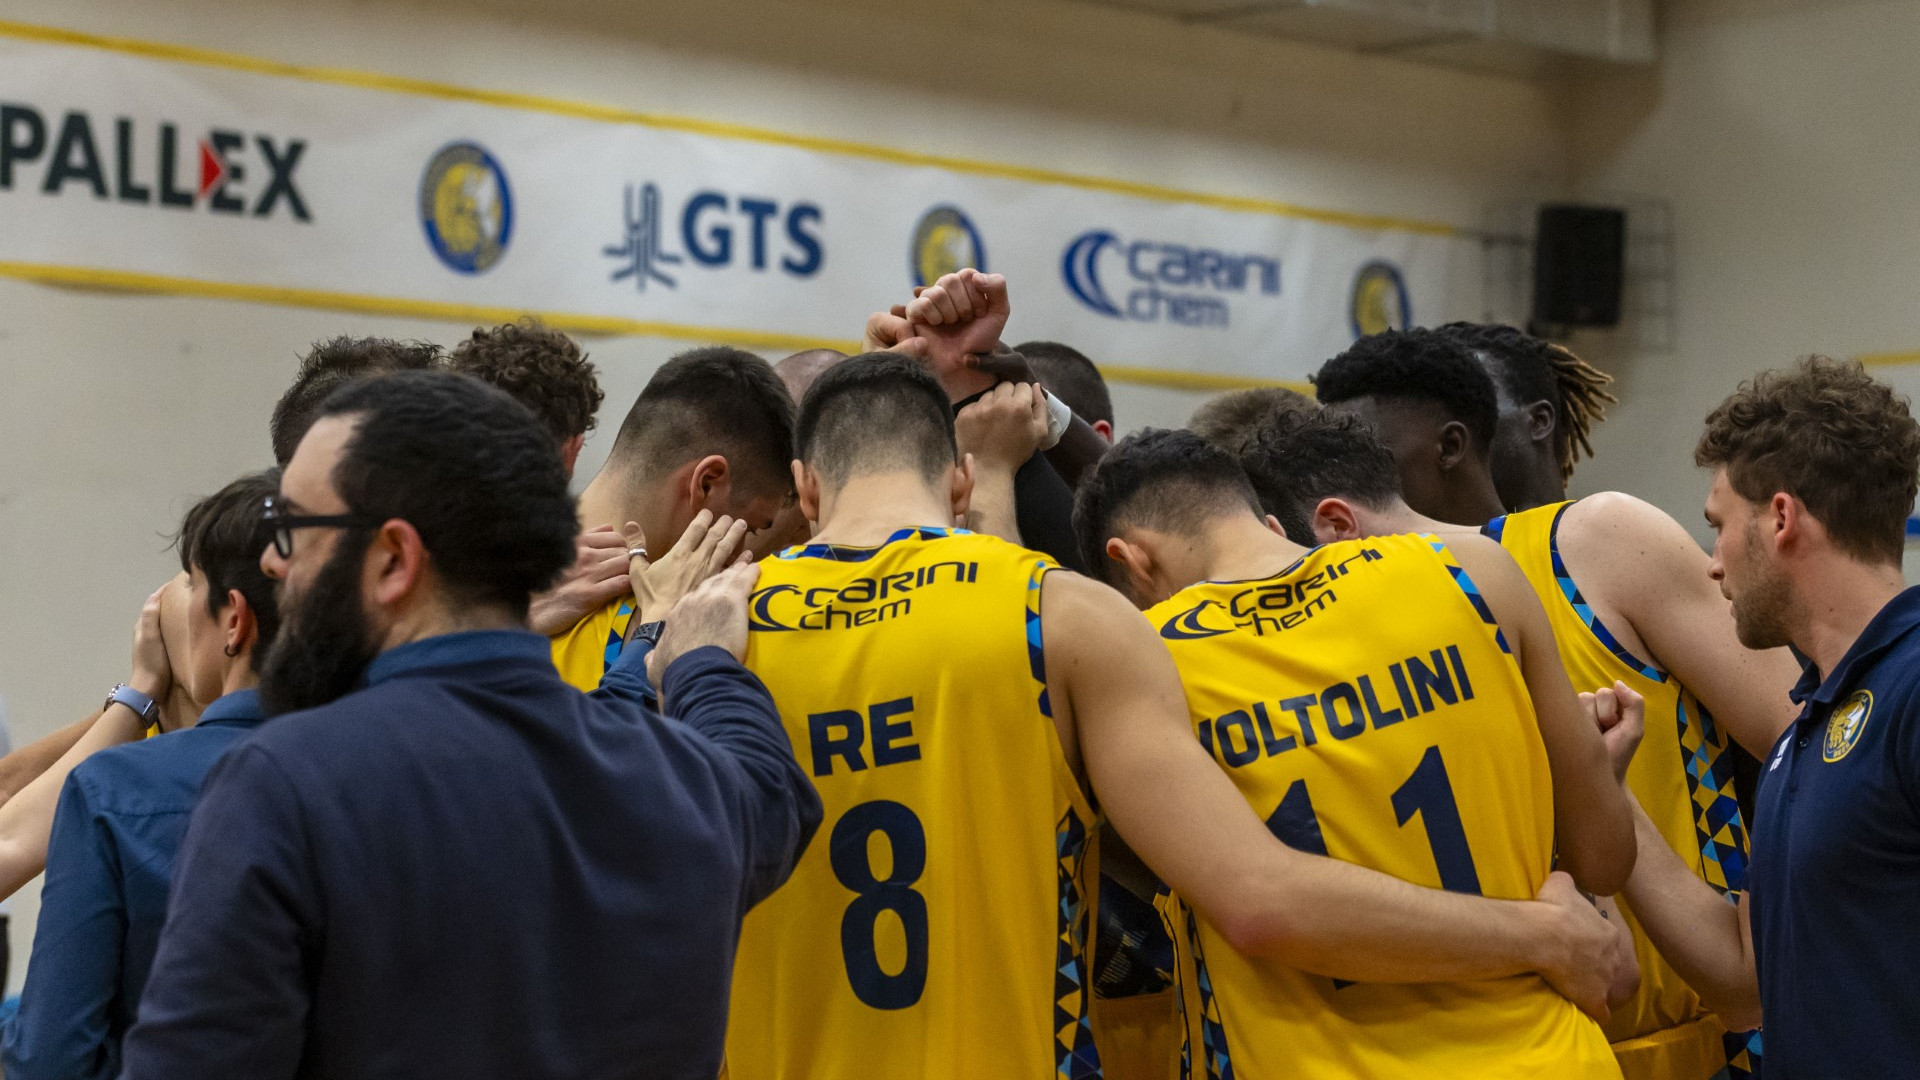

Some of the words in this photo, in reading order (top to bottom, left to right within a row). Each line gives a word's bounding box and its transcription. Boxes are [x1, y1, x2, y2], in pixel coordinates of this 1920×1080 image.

[0, 105, 313, 223] PALLEX
[680, 190, 825, 277] GTS
[799, 597, 911, 631] chem
[807, 696, 922, 778] RE
[829, 800, 929, 1011] 8
